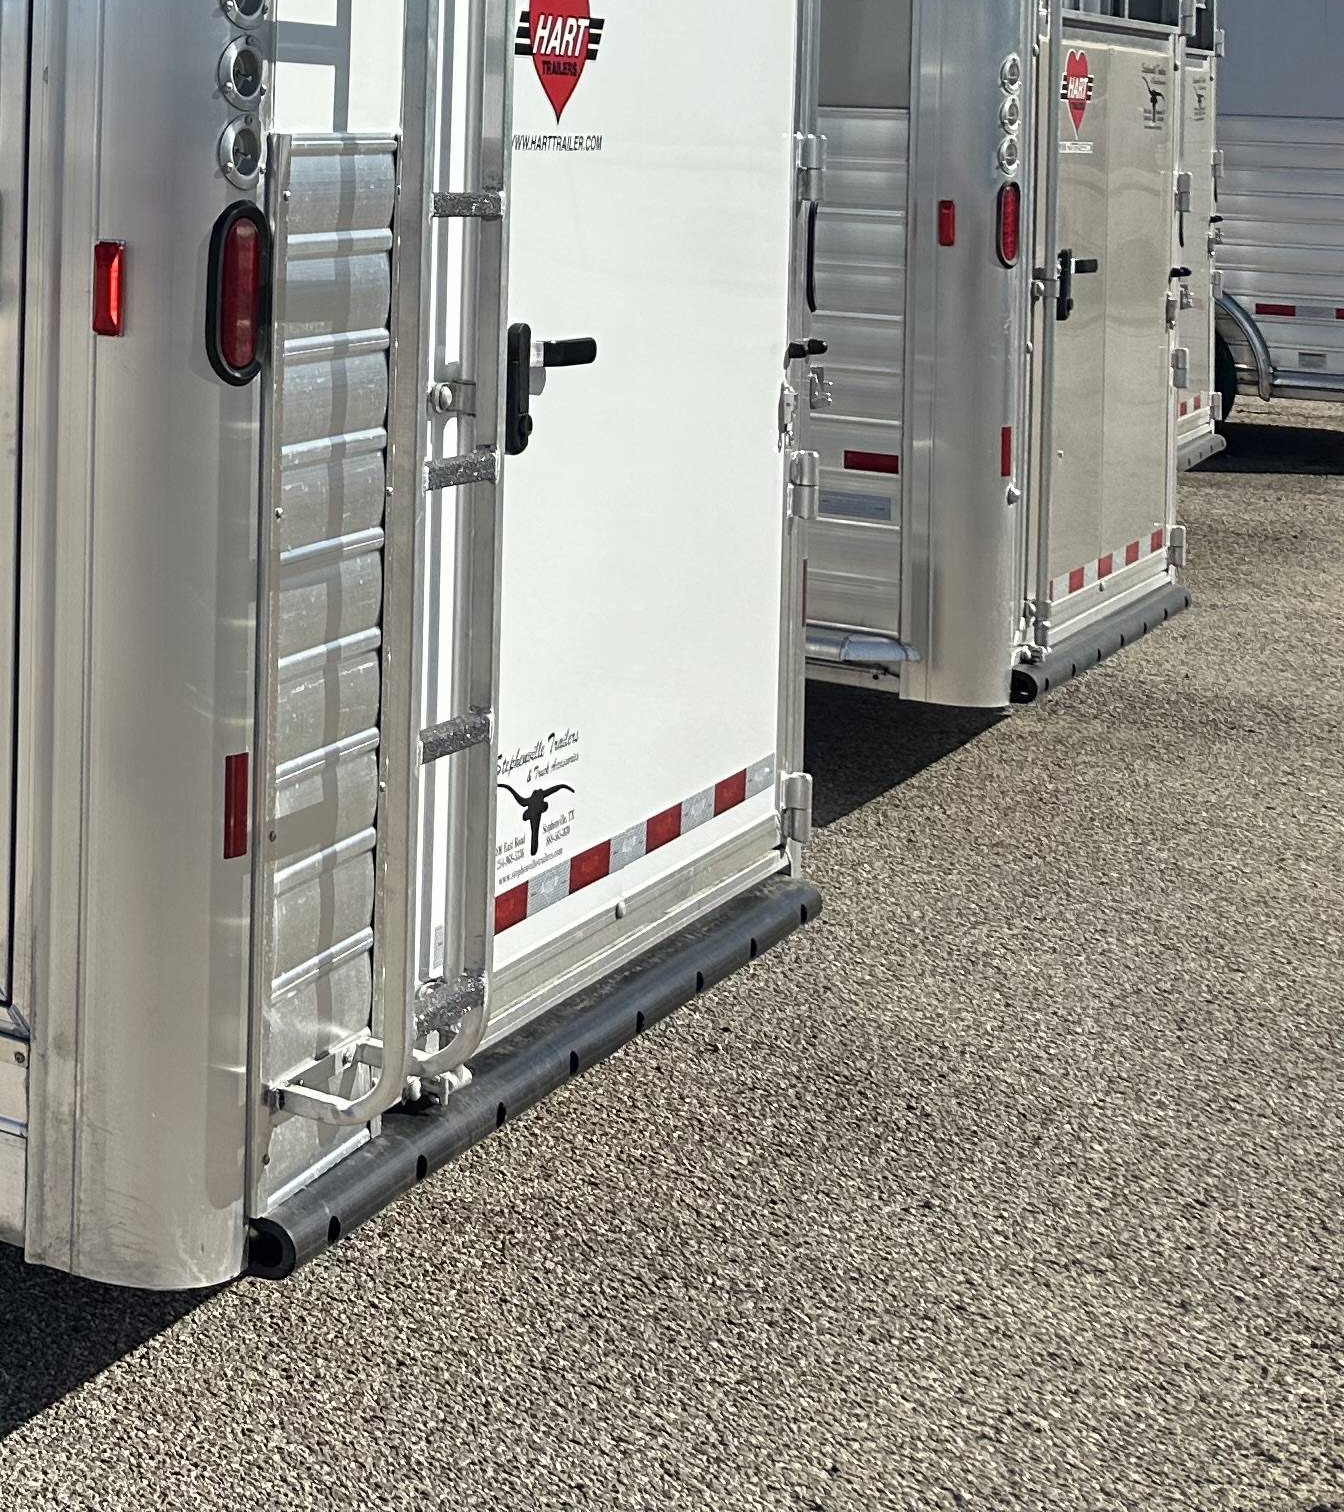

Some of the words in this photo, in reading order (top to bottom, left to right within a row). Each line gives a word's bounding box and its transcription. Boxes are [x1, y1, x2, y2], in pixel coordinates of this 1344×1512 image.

[532, 14, 590, 58] HART
[541, 60, 578, 77] TRAILERS
[1068, 77, 1089, 100] HART
